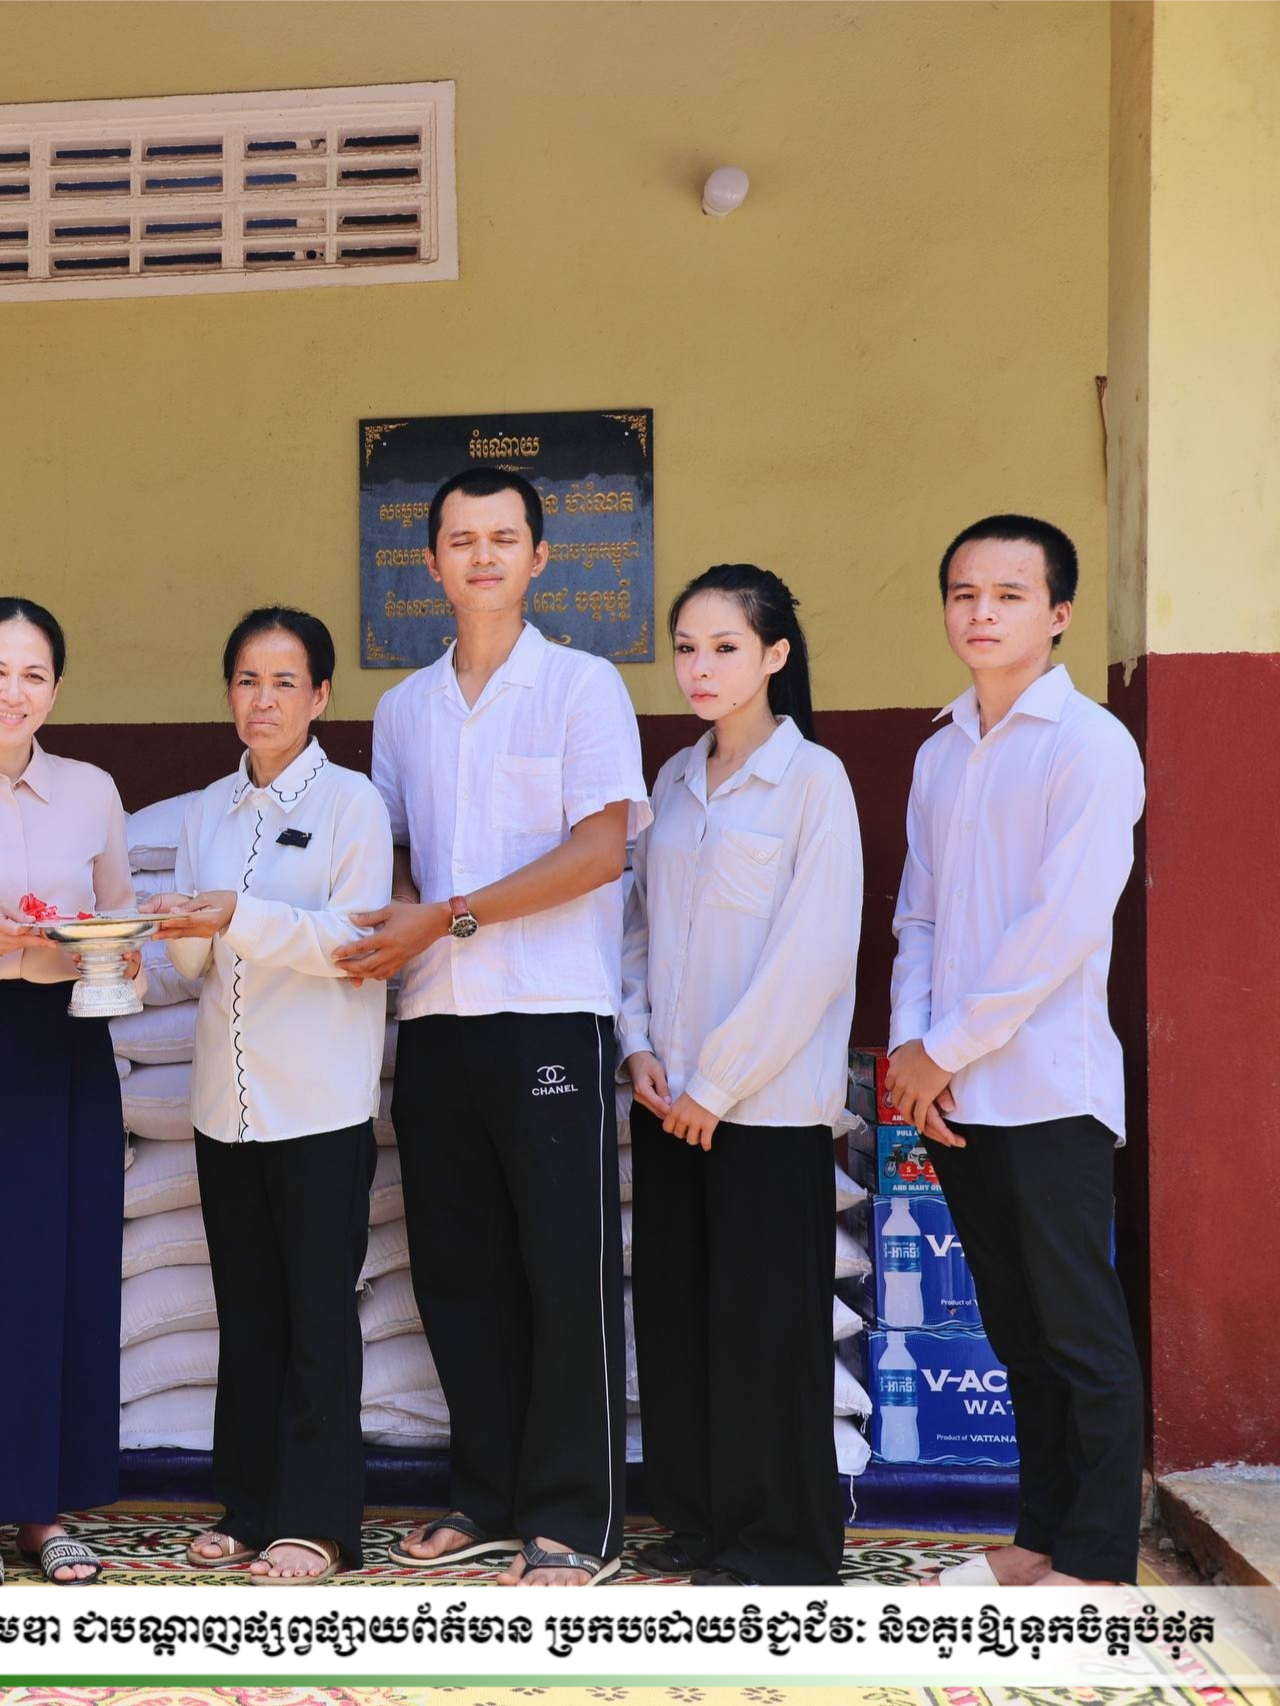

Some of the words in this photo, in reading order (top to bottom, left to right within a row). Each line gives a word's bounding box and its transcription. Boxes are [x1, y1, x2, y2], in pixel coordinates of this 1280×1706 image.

[469, 430, 540, 458] អំណោយ
[531, 1084, 578, 1096] CHANEL
[921, 1369, 1008, 1393] V-AC
[969, 1435, 1017, 1443] VATTANA
